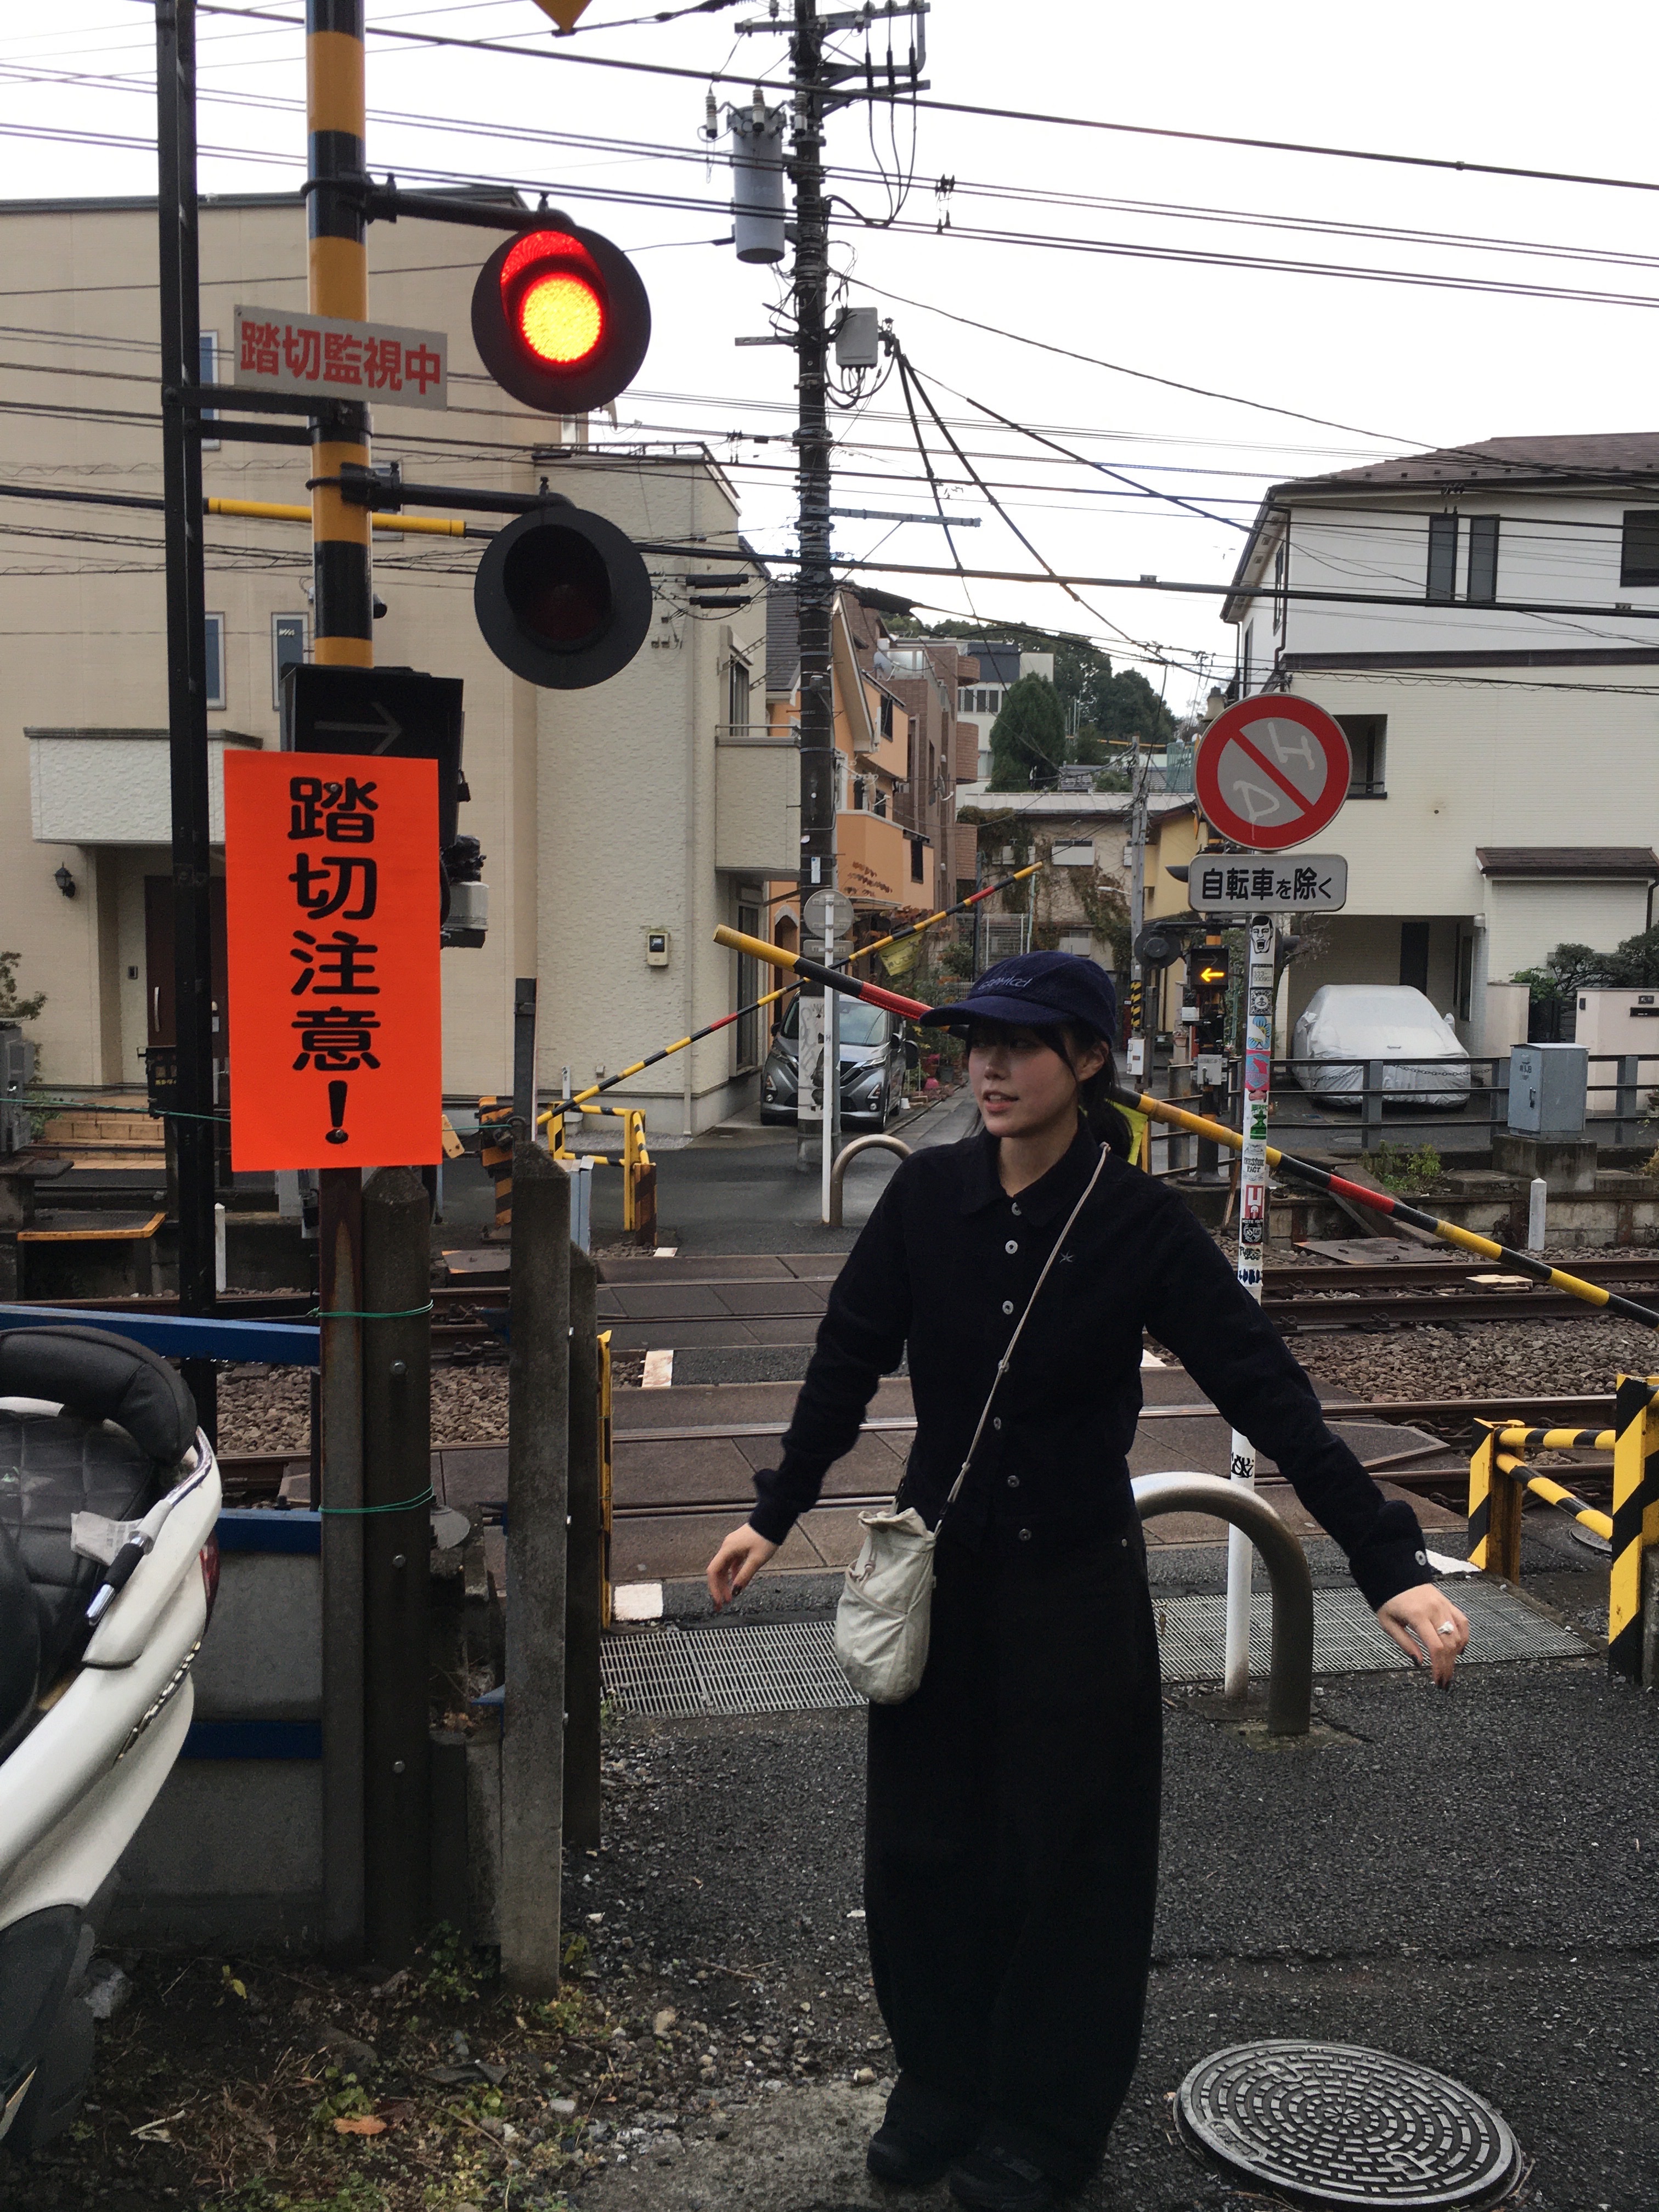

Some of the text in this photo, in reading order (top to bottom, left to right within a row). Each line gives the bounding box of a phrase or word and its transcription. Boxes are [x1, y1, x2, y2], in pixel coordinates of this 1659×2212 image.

[240, 320, 441, 395] 踏切監視中
[1202, 867, 1332, 900] 自転車を除く
[287, 776, 381, 1145] 踏切注意！
